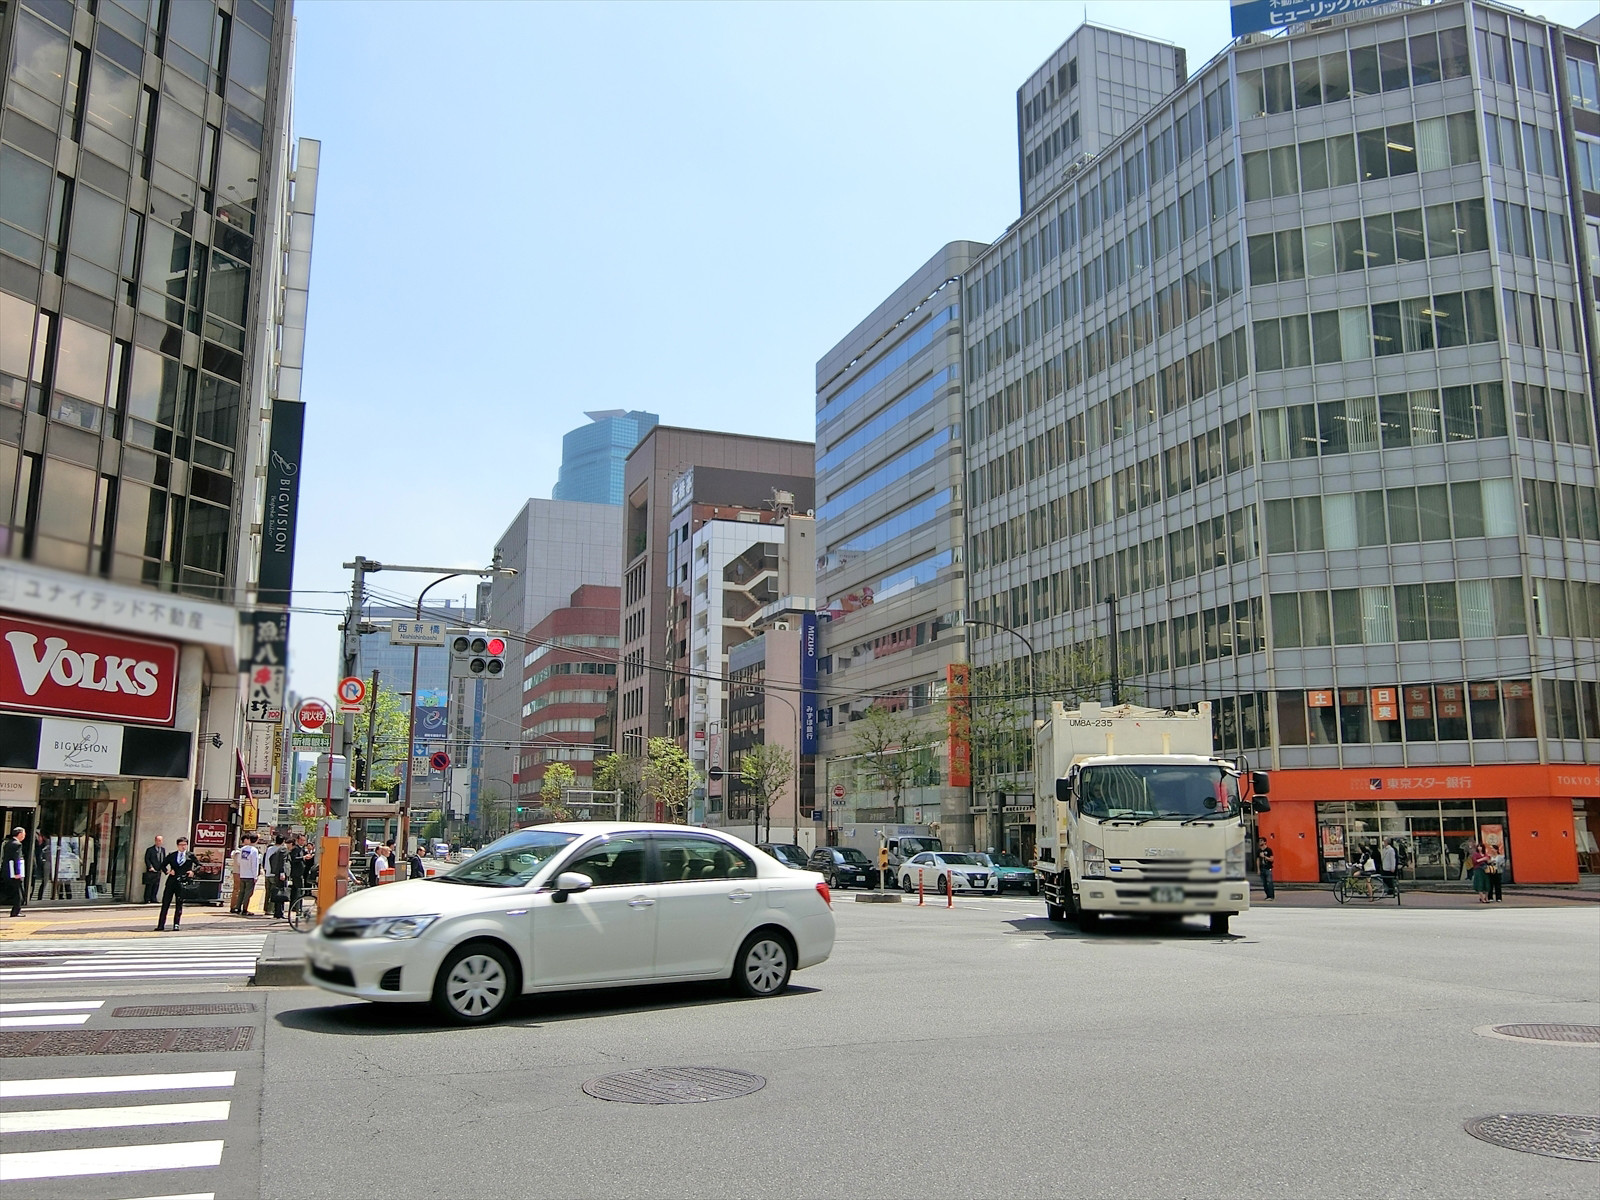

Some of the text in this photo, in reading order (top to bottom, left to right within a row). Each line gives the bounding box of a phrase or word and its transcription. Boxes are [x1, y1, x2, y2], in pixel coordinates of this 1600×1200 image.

[274, 479, 291, 553] BIGVISION
[24, 579, 204, 630] ユナイテッド不動産
[397, 623, 440, 635] 西新橋
[807, 625, 815, 657] MIZUHO
[5, 631, 159, 696] VOLKS
[301, 711, 325, 721] 消火栓
[806, 705, 814, 740] みずほ銀行
[1069, 719, 1113, 727] UM8A-235
[54, 741, 108, 753] BIGVISION
[1387, 776, 1472, 789] 東京スター銀行
[1557, 775, 1591, 785] TOKYO
[197, 829, 225, 839] VOLKS
